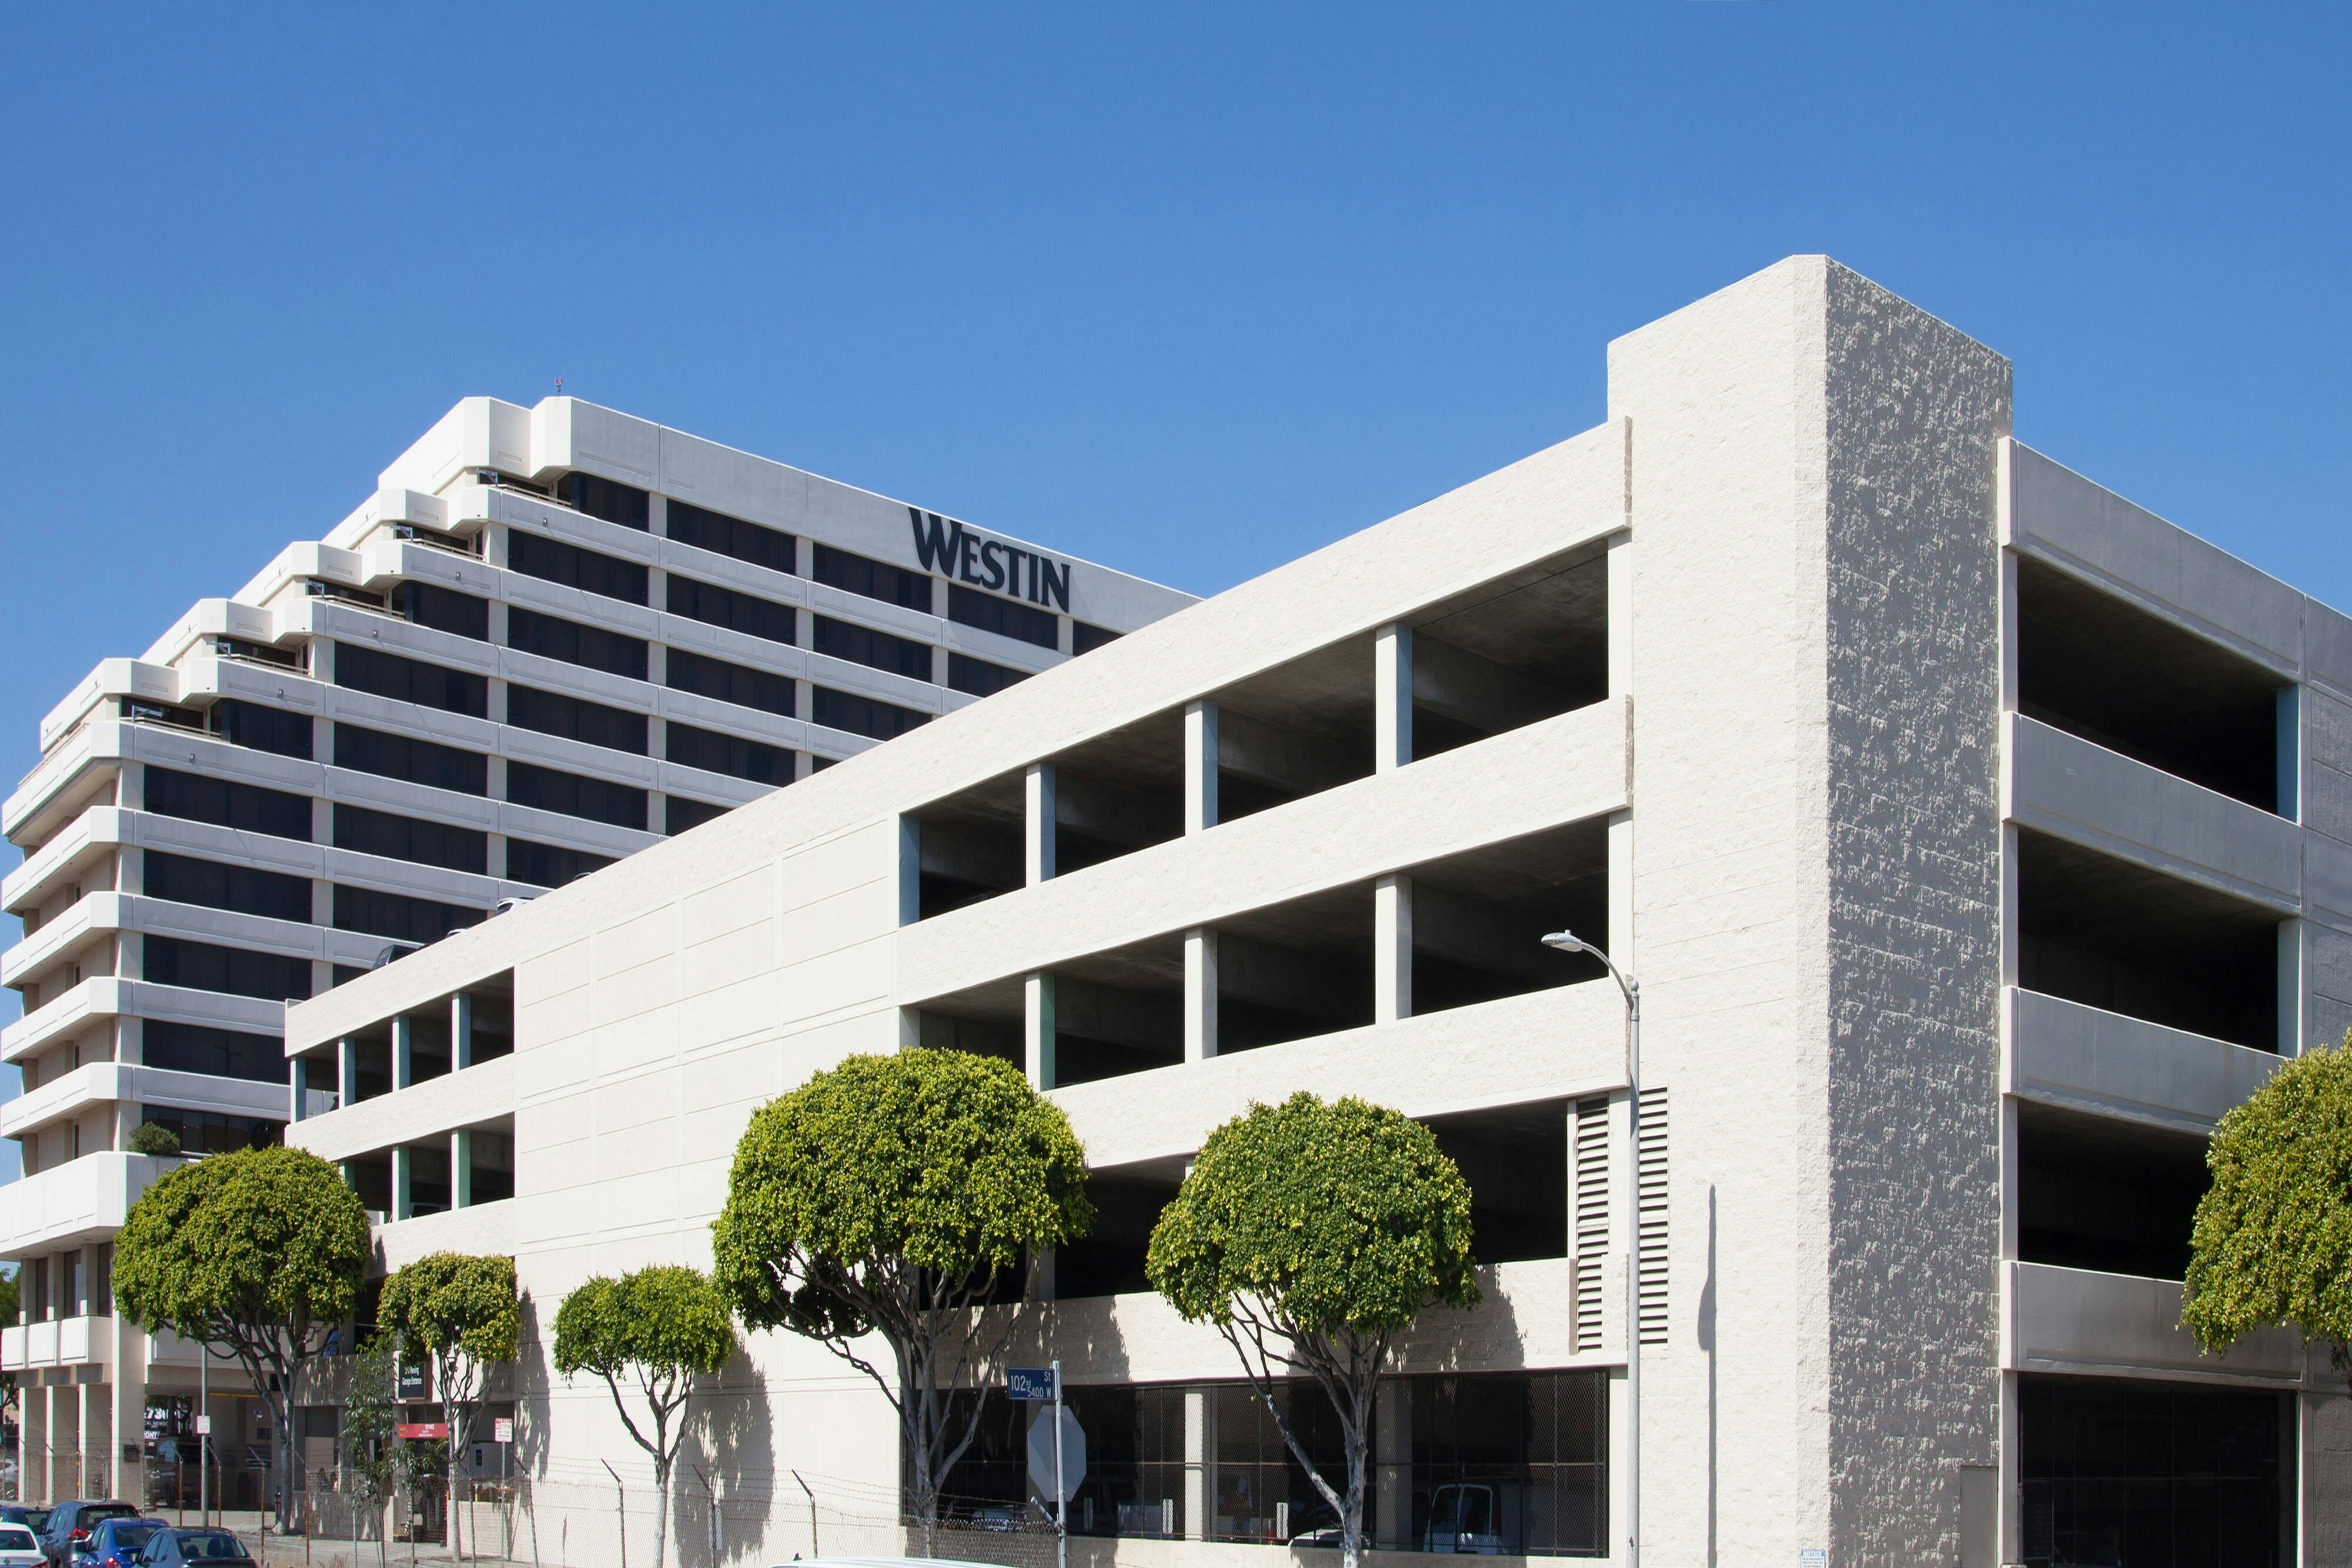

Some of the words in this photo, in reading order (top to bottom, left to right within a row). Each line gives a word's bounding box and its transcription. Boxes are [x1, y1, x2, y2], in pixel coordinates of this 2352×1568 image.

[908, 507, 1071, 614] WESTIN
[1011, 1375, 1031, 1392] 102nd
[1044, 1371, 1051, 1382] St
[1027, 1386, 1044, 1398] 5400
[1046, 1388, 1051, 1398] W
